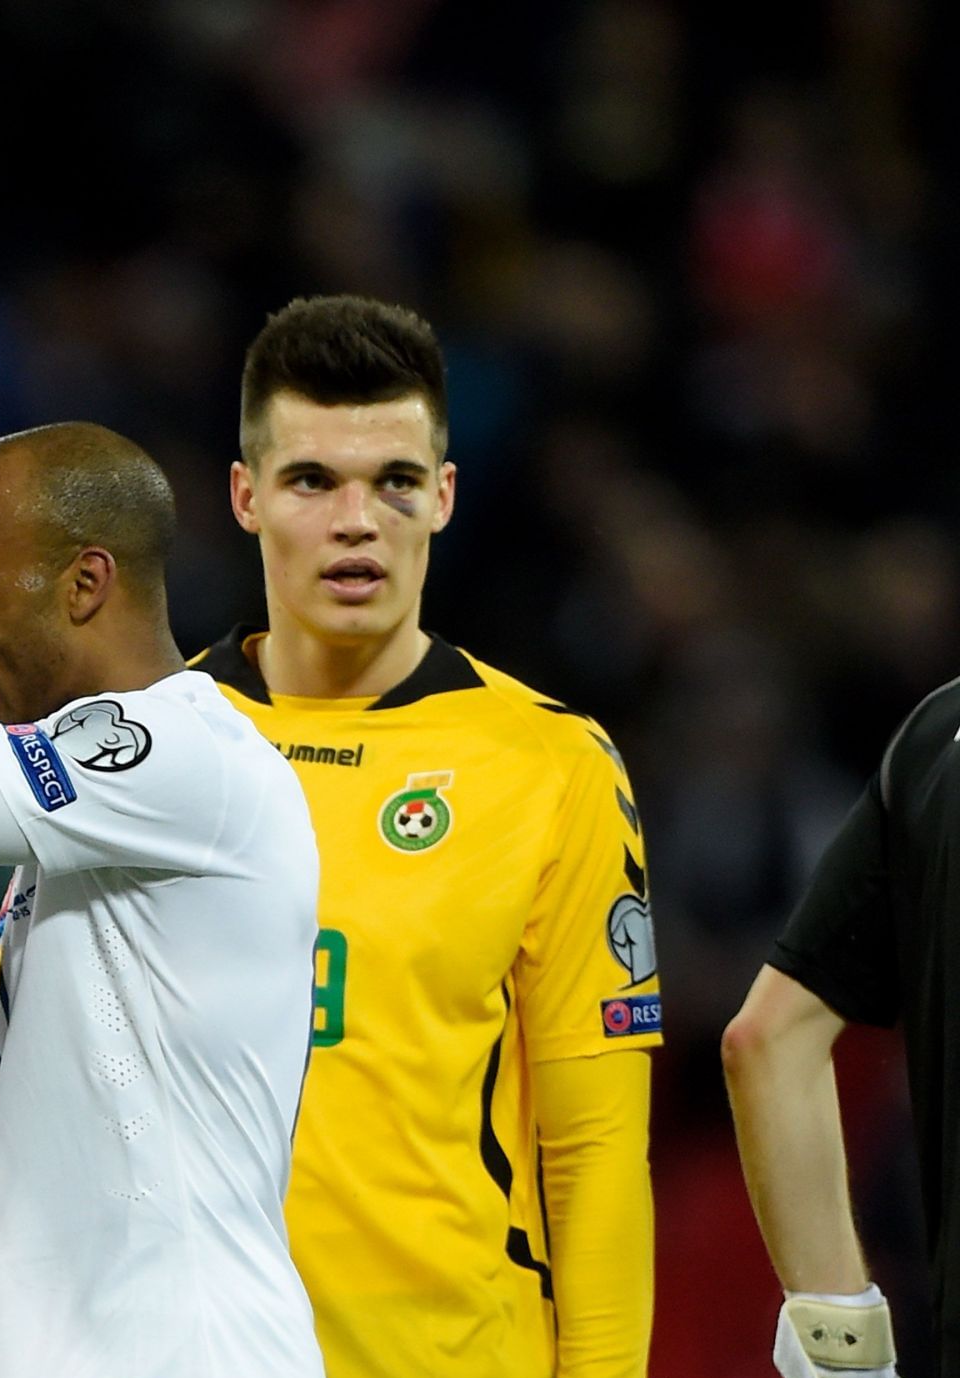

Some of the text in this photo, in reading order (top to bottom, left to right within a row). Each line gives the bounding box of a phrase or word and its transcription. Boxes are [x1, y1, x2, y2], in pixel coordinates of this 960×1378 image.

[274, 743, 364, 768] ummel
[19, 734, 68, 805] RESPECT
[633, 1004, 661, 1024] RES
